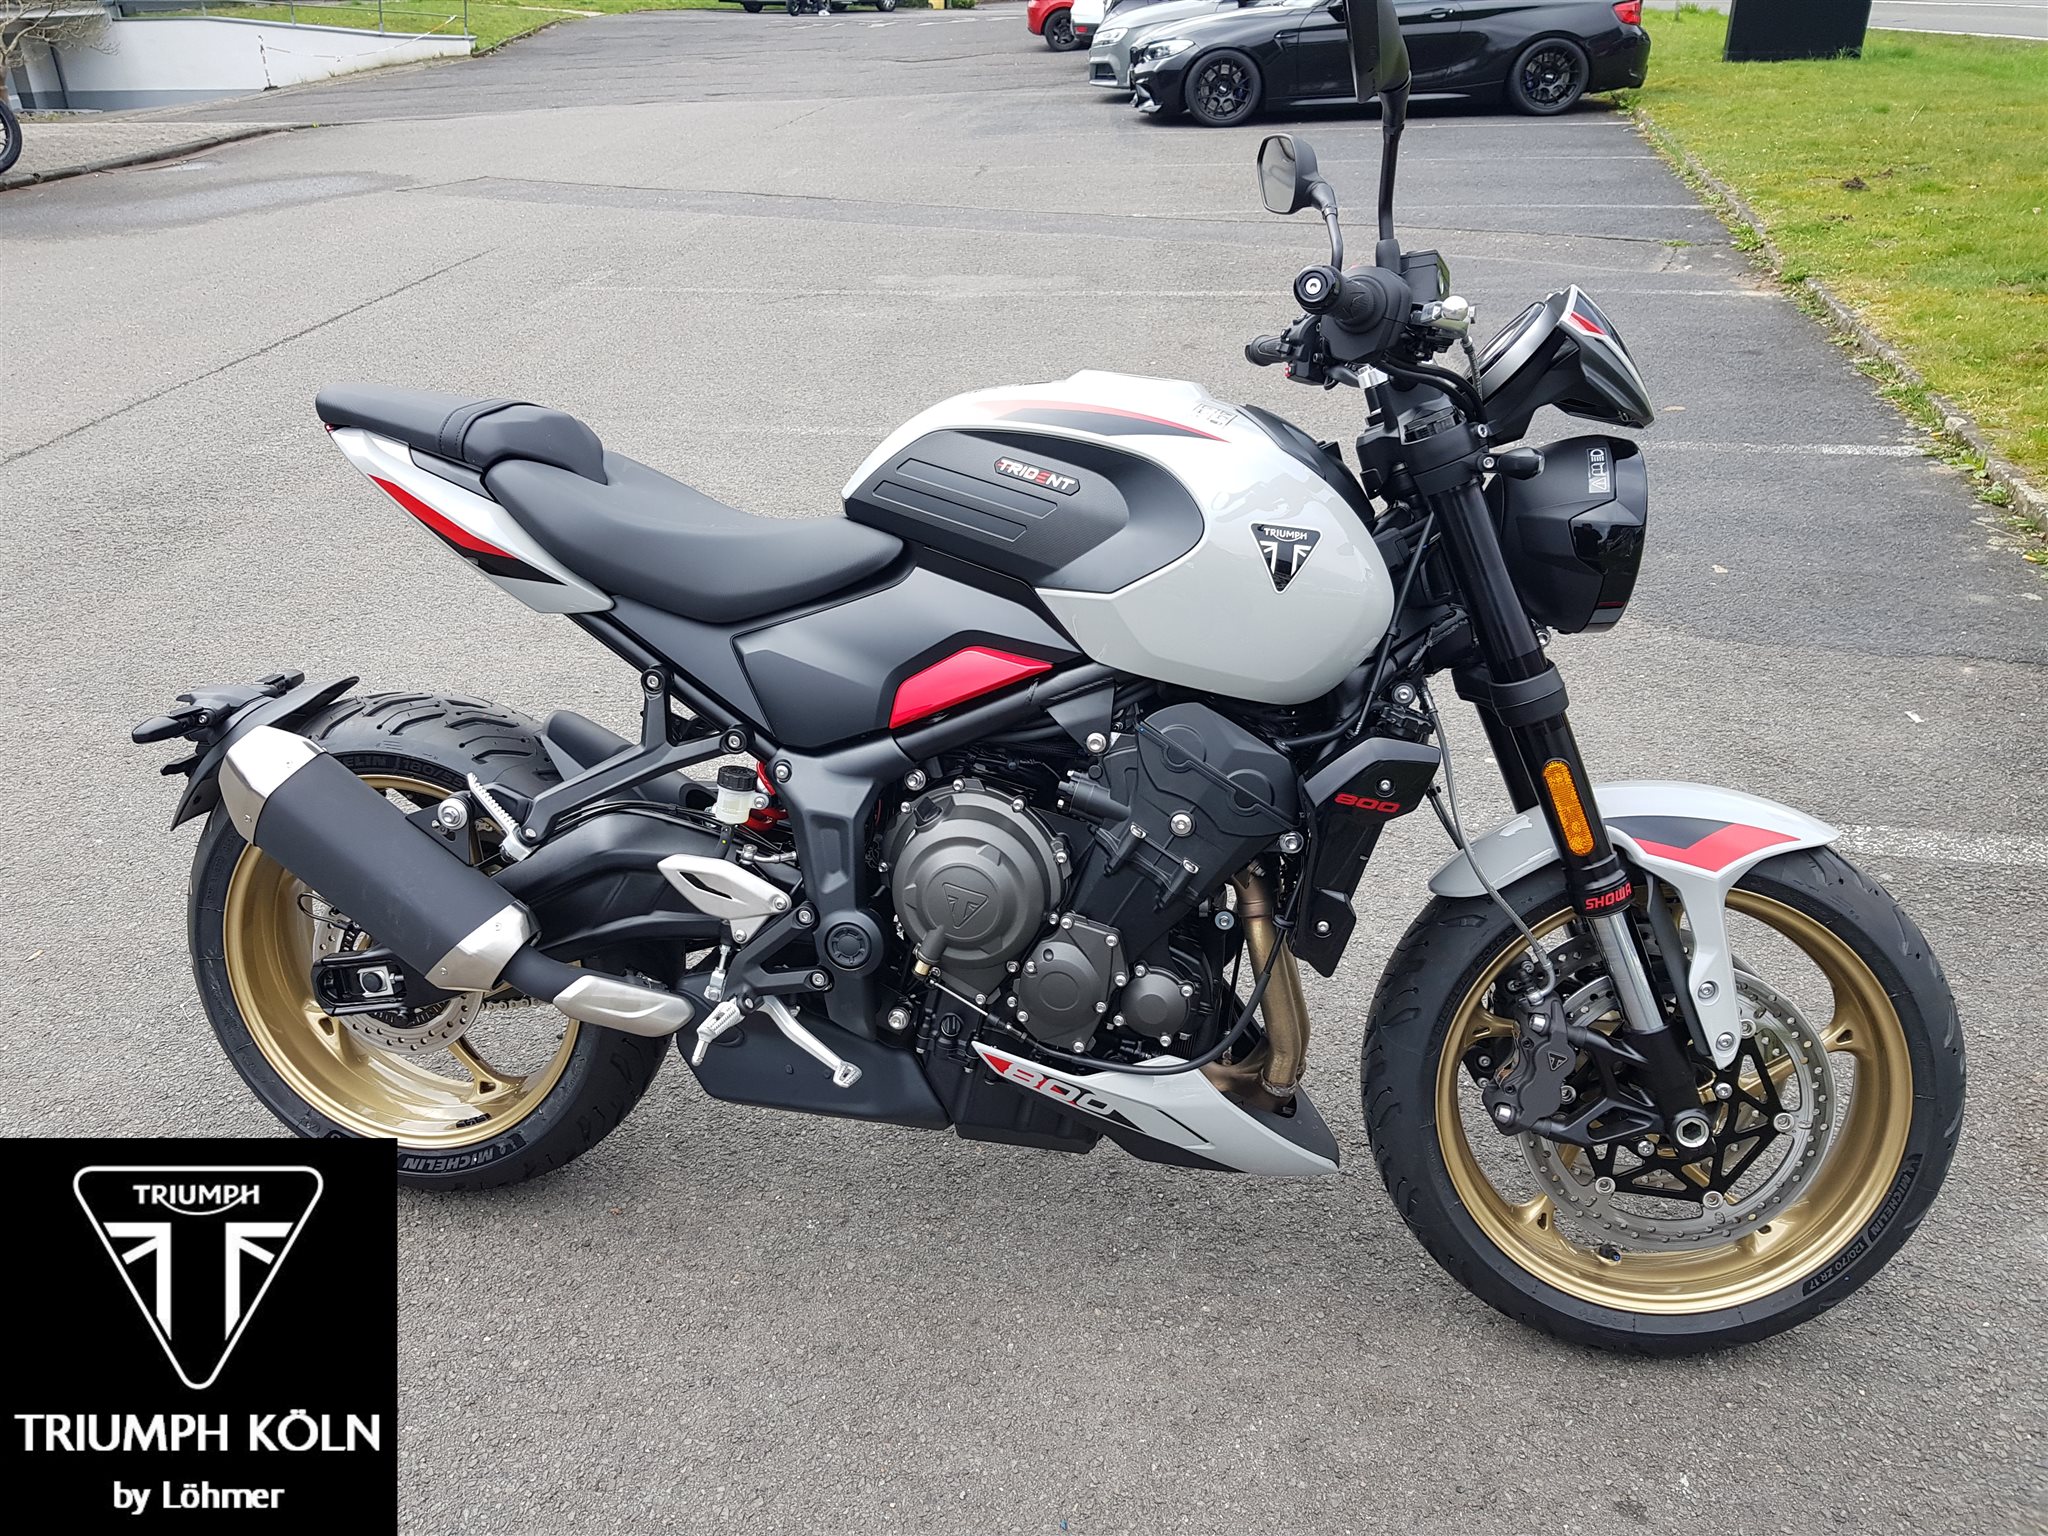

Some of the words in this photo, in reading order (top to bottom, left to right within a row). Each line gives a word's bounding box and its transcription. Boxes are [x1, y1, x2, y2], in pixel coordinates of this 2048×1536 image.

[998, 459, 1075, 490] TRIDENT
[1263, 527, 1308, 541] TRIUMPH
[1334, 793, 1401, 813] 800
[1585, 882, 1632, 910] SHOWA
[1003, 1062, 1116, 1115] 800
[402, 1148, 494, 1171] MICHELIN
[1868, 1173, 1913, 1237] MICHELIN
[1834, 1241, 1866, 1271] 120/70
[1809, 1279, 1821, 1290] 17
